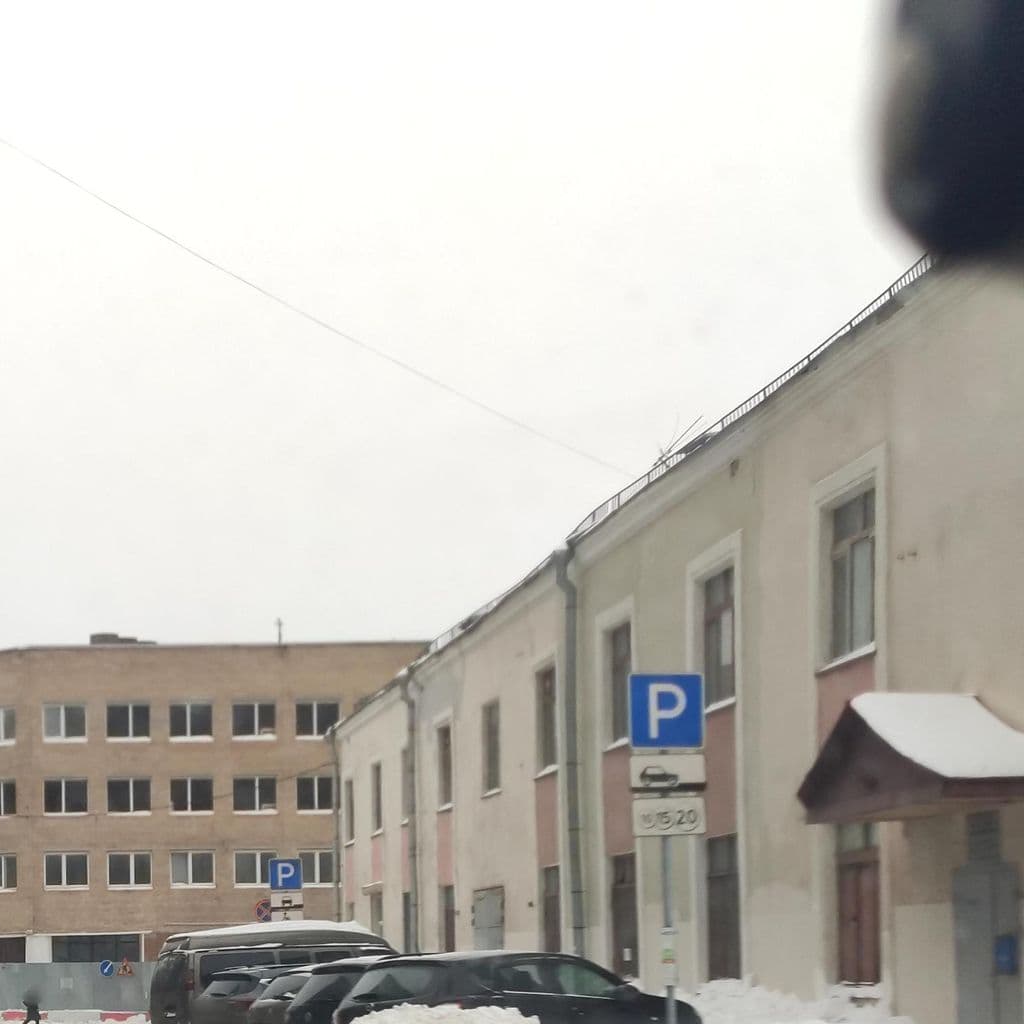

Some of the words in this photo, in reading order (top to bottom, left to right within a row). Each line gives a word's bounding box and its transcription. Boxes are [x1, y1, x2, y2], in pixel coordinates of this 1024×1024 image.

[648, 682, 688, 740] P
[677, 809, 697, 825] 20
[277, 862, 295, 888] P
